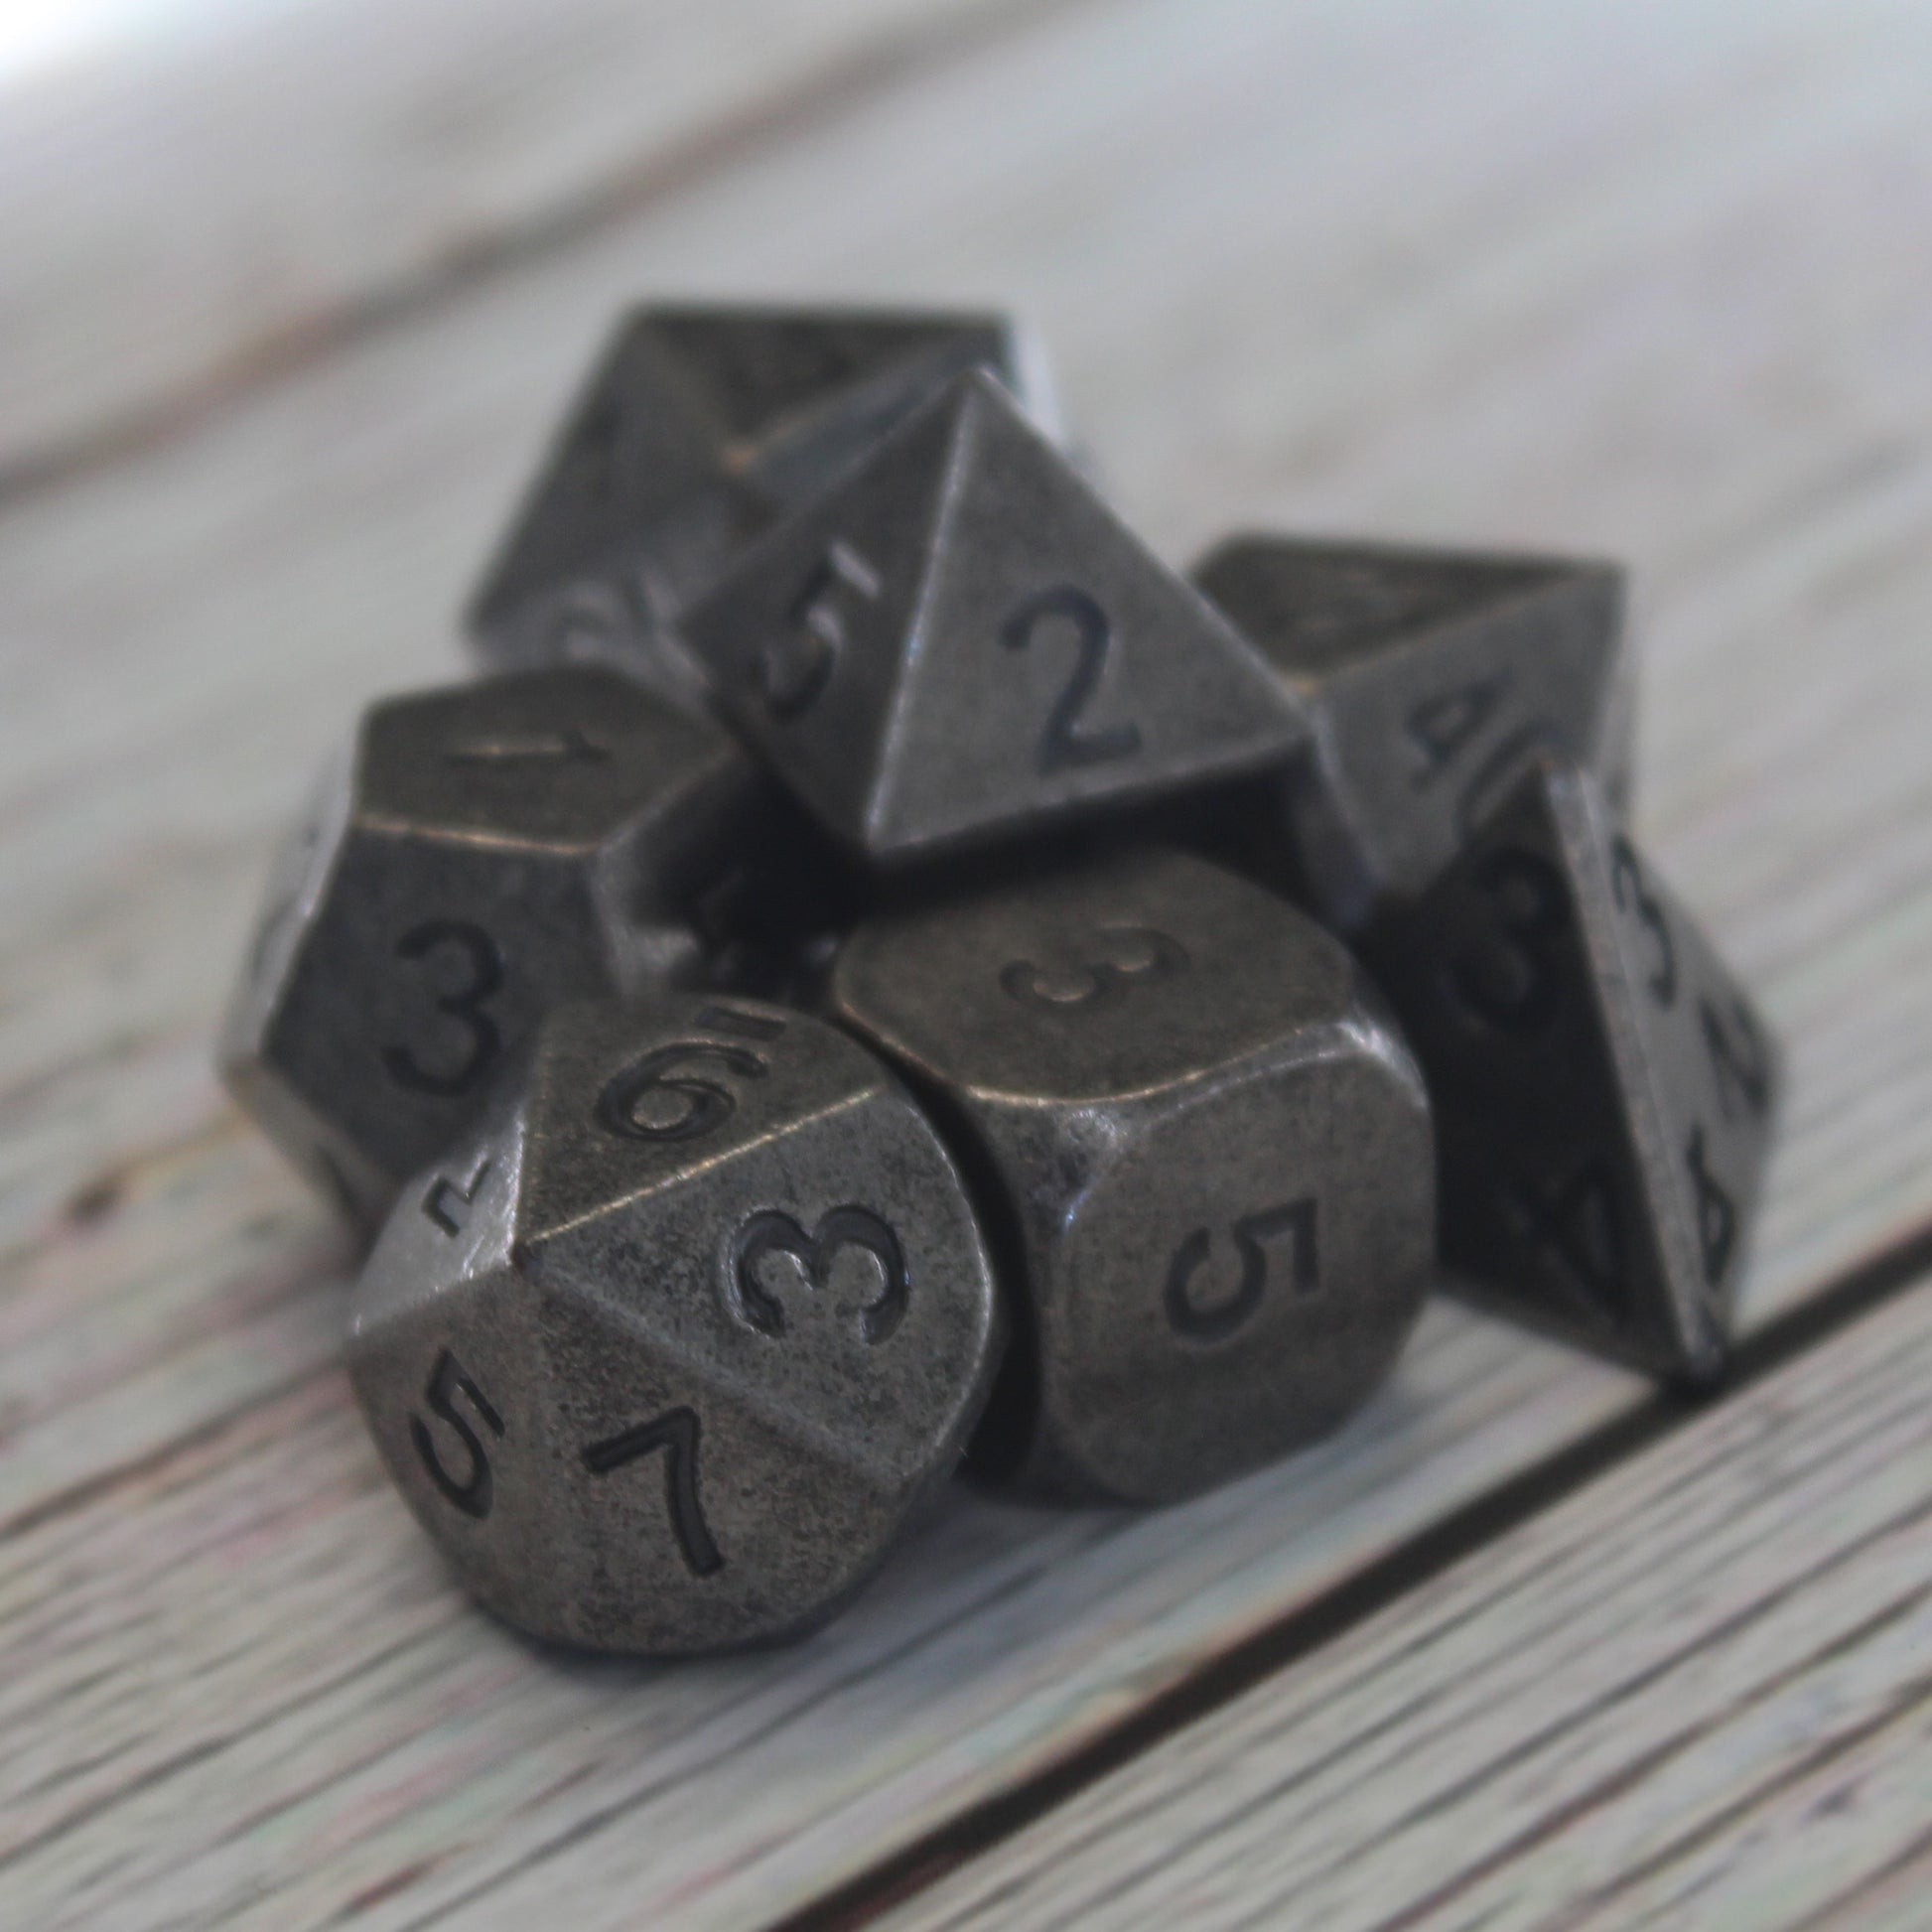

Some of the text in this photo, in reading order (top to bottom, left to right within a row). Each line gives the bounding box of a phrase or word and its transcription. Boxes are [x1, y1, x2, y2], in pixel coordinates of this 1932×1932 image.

[444, 730, 610, 766] 1
[998, 584, 1142, 779] 2
[380, 915, 504, 1096] 3
[998, 925, 1191, 1011] 3
[722, 1203, 908, 1345] 3
[1162, 1196, 1318, 1345] 5
[409, 1348, 506, 1519] 5
[581, 1405, 727, 1577] 7
